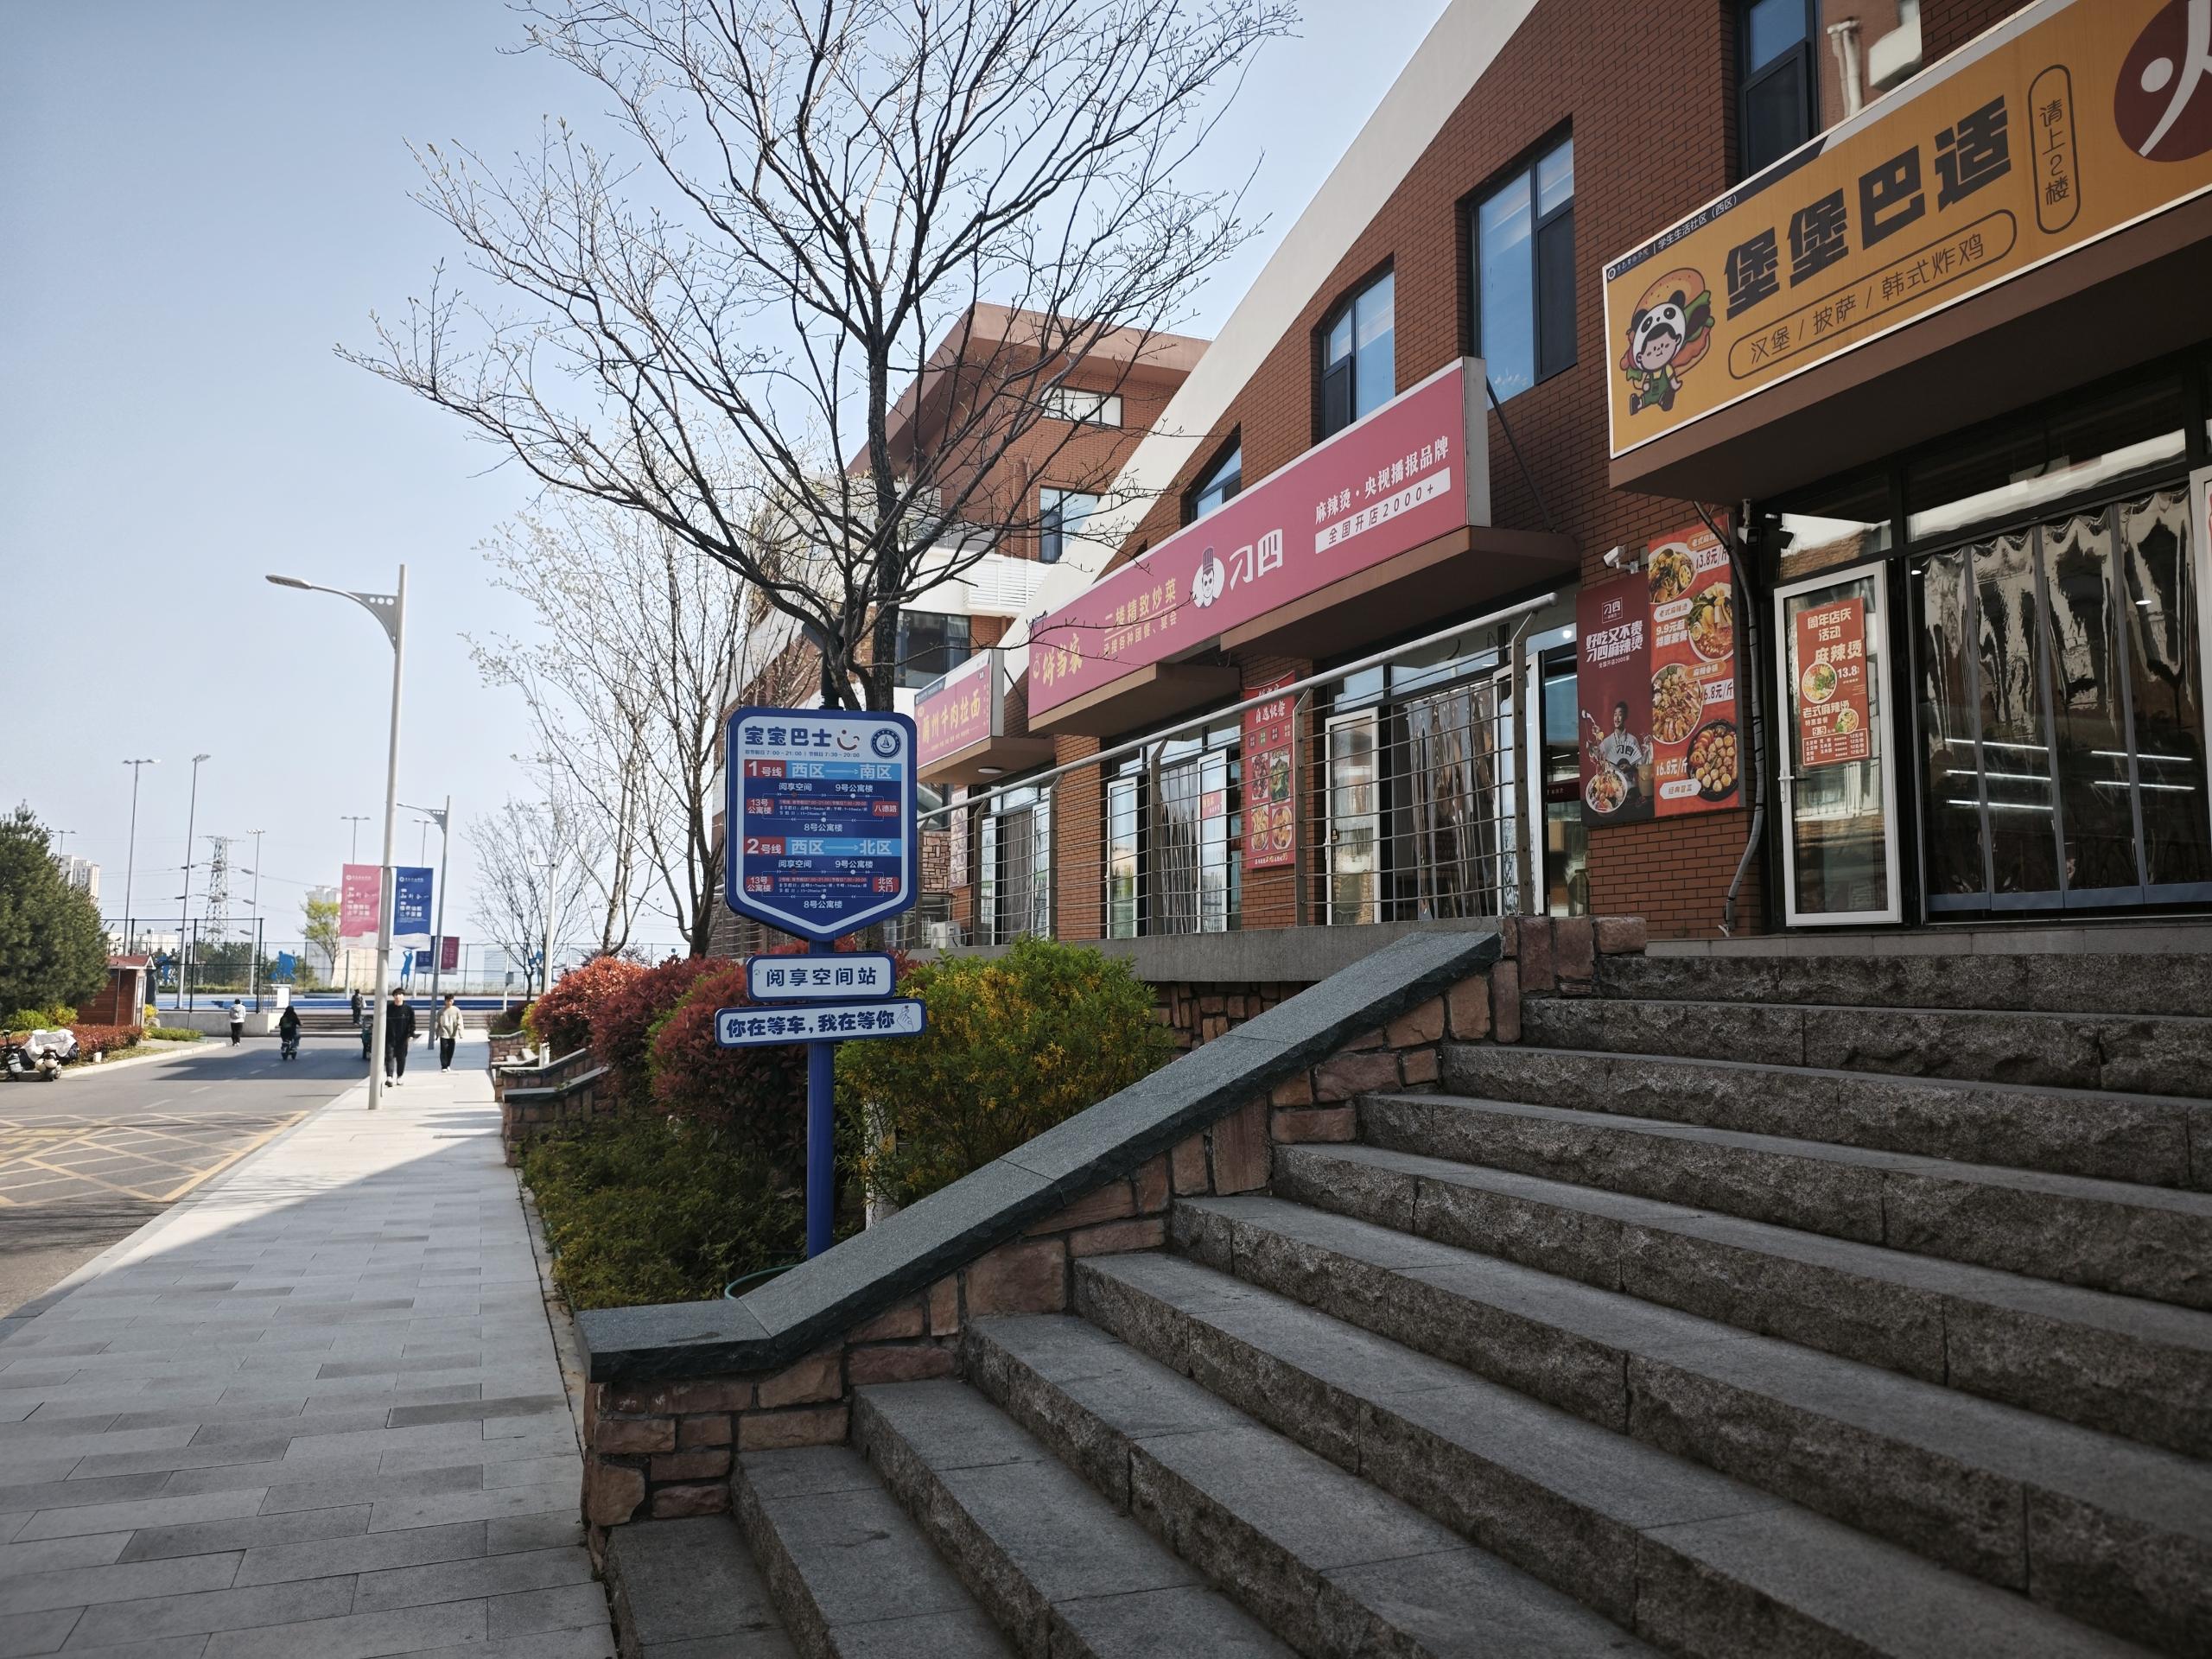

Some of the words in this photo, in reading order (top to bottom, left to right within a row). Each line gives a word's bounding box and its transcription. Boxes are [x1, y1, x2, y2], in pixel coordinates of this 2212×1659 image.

[2039, 98, 2069, 206] 请上2楼
[1724, 94, 2012, 321] 堡堡巴适
[1315, 435, 1448, 524] 麻辣烫·央视播报品牌
[1328, 483, 1433, 545] 全国开店2000+
[1229, 529, 1283, 592] 刁四
[1604, 601, 1621, 615] 刁四
[1807, 607, 1852, 630] 周年店庆
[1586, 620, 1643, 651] 好吃又不贵
[1818, 626, 1841, 642] 活动
[1586, 633, 1643, 663] 刁四麻辣烫
[1815, 639, 1862, 664] 麻辣烫
[744, 726, 832, 747] 宝宝巴士
[1616, 744, 1634, 756] 刁四
[748, 760, 782, 778] 1号线
[791, 762, 824, 779] 西区
[859, 764, 892, 779] 南区
[779, 782, 812, 791] 阅享空间
[835, 784, 873, 793] 9号公寓楼
[874, 804, 897, 813] 八德路
[804, 823, 842, 832] 8号公寓楼
[747, 838, 781, 855] 2号线
[791, 839, 824, 855] 西区
[859, 840, 892, 855] 北区
[779, 860, 812, 868] 阅享空间
[835, 860, 873, 868] 9号公寓楼
[804, 900, 842, 909] 8号公寓楼
[766, 967, 877, 987] 阅享空间站
